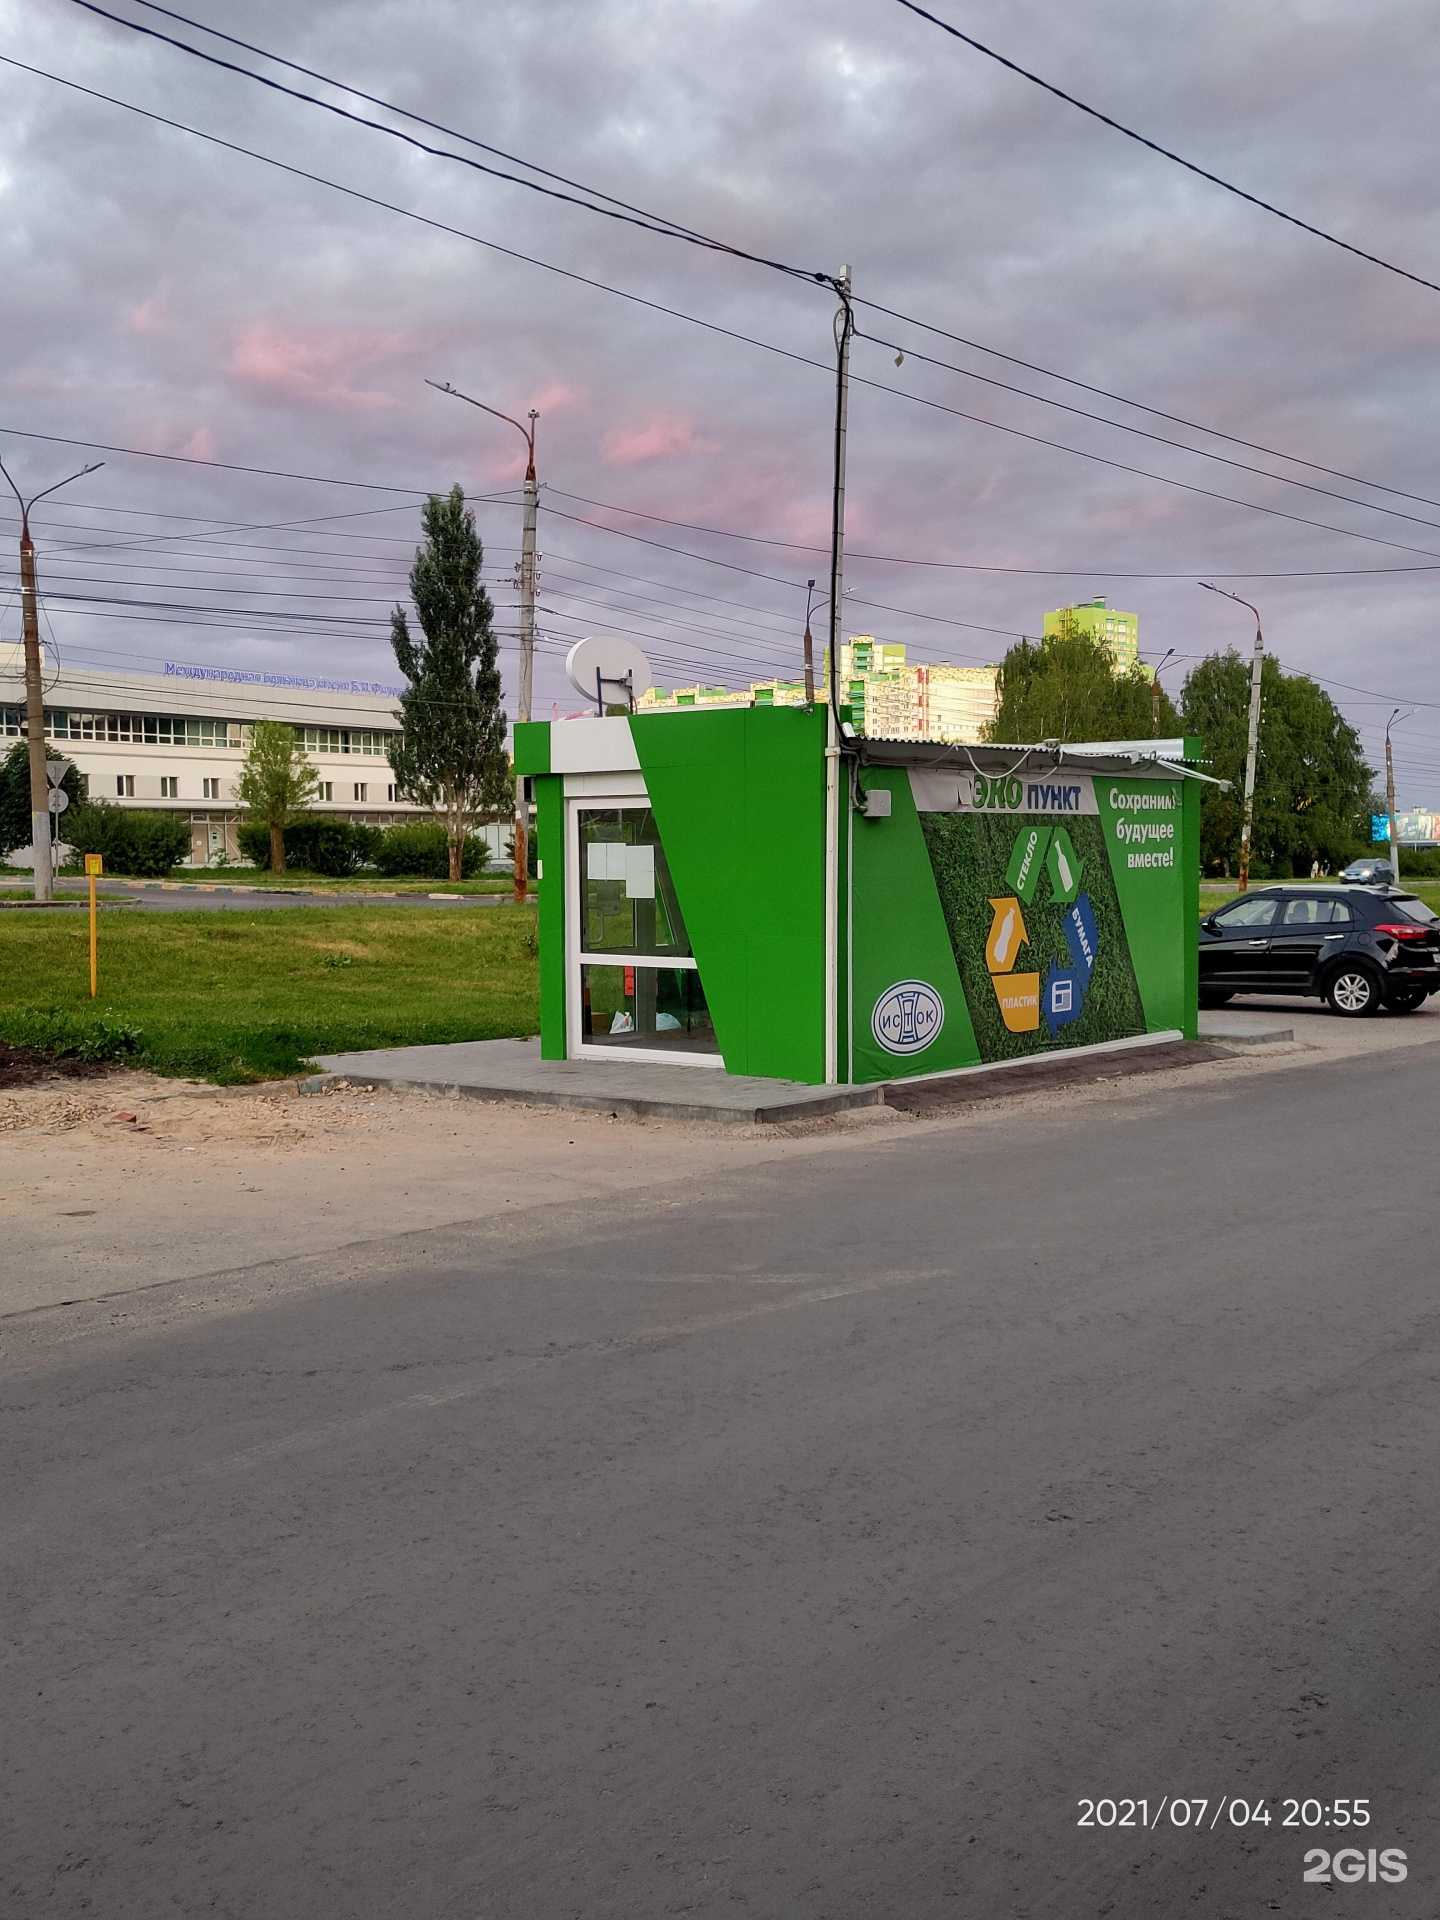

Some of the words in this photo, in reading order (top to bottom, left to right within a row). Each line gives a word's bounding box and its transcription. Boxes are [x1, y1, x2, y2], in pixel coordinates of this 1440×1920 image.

[971, 774, 1024, 809] ЭКО
[1027, 784, 1081, 810] ПУНКТ
[1116, 817, 1174, 844] будущее
[1017, 831, 1038, 891] СТЕКЛО
[1127, 847, 1174, 869] вместе!
[1071, 907, 1094, 968] БУМАГА
[1002, 995, 1038, 1009] ПЛАСТИК
